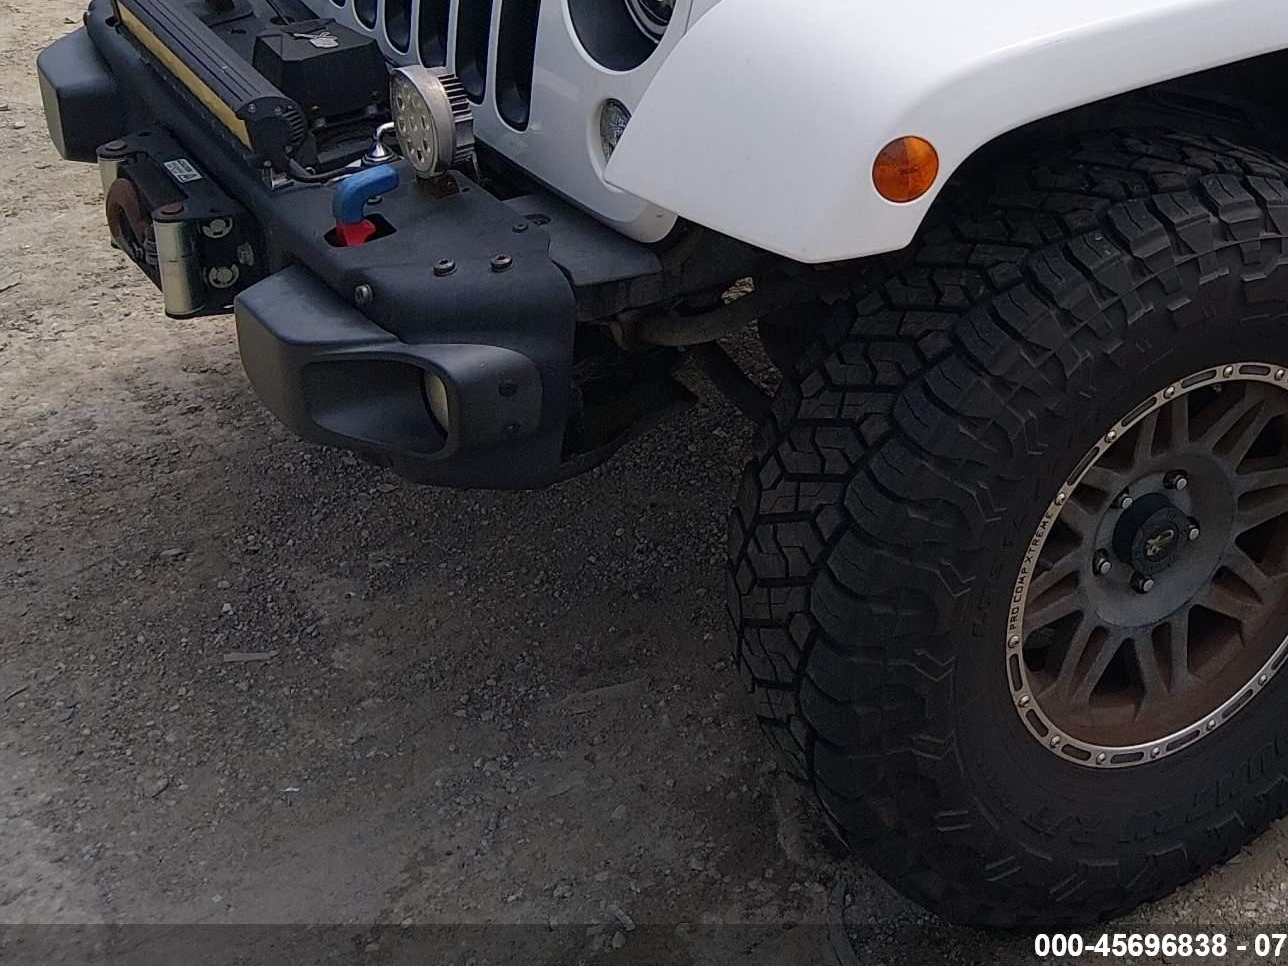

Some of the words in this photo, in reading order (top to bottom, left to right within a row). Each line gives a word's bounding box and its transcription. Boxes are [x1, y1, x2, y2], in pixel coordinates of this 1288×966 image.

[1024, 511, 1054, 565] XTREME
[1013, 566, 1028, 604] COMP
[1008, 606, 1021, 632] PRO
